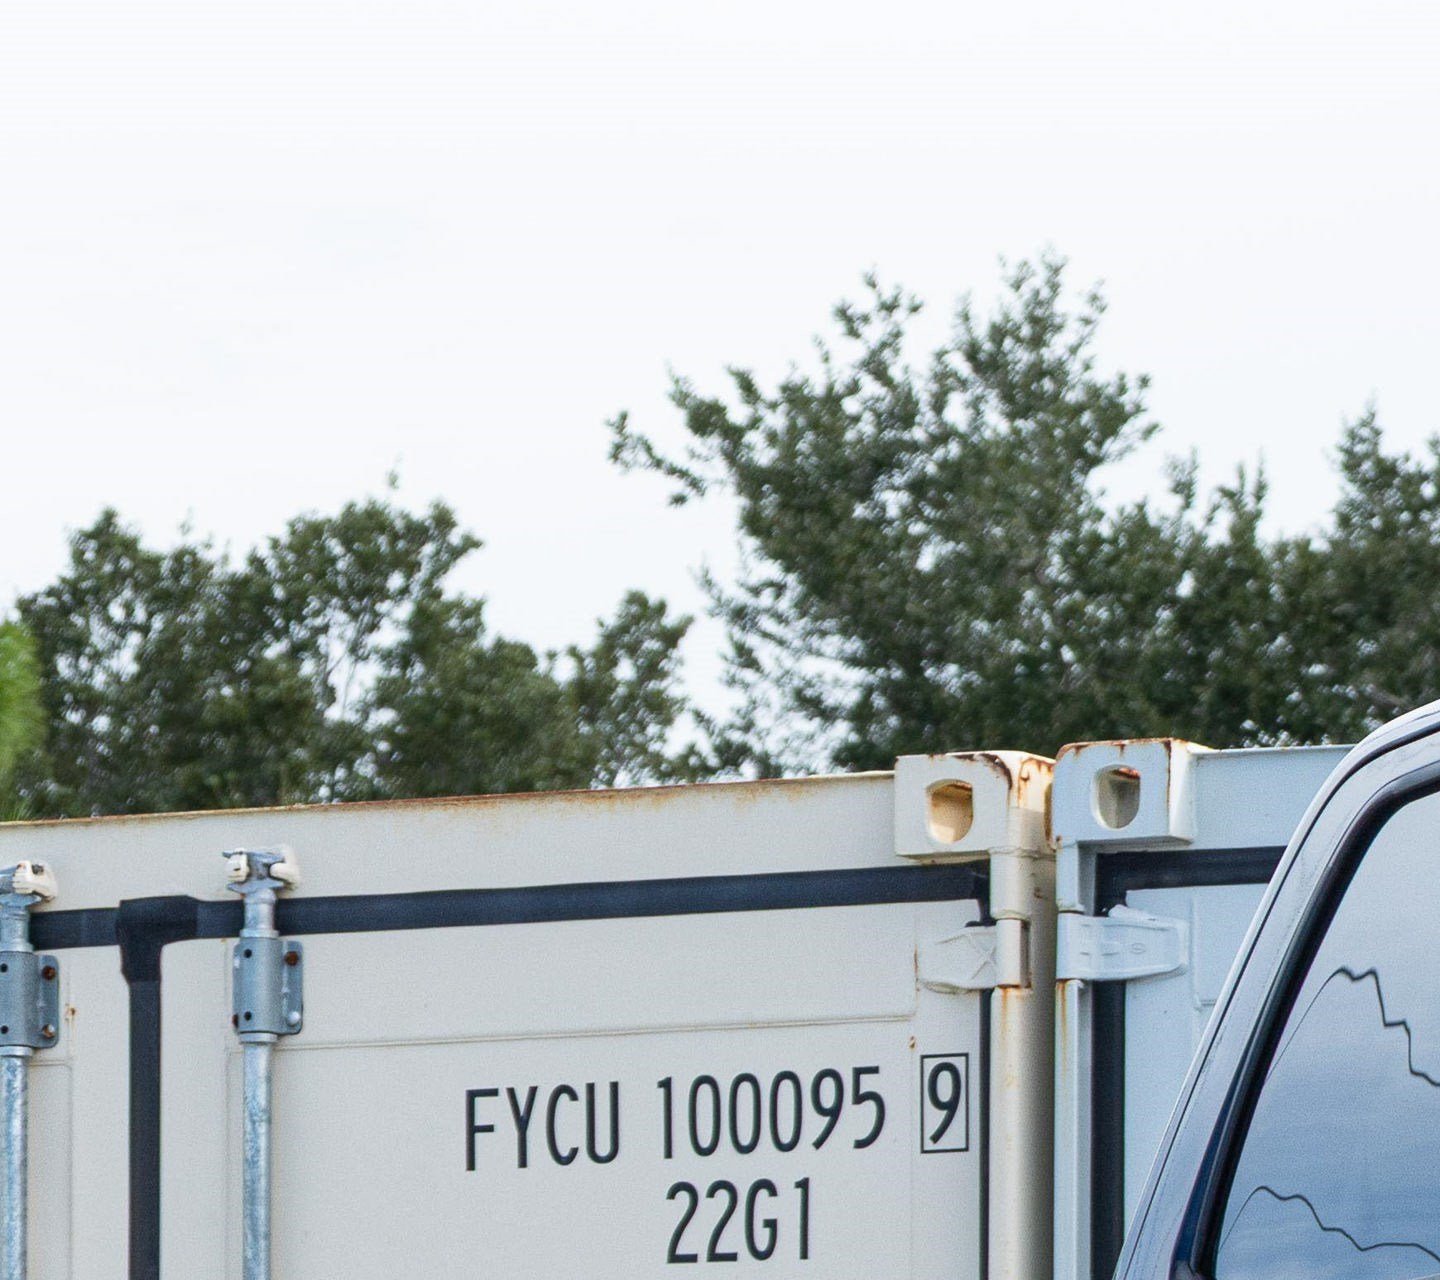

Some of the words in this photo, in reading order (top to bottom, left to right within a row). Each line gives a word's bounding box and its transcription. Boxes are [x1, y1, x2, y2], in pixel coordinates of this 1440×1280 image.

[467, 1082, 619, 1171] FYCU
[658, 1066, 885, 1158] 100095
[928, 1062, 961, 1144] 9
[667, 1178, 809, 1263] 22G1
